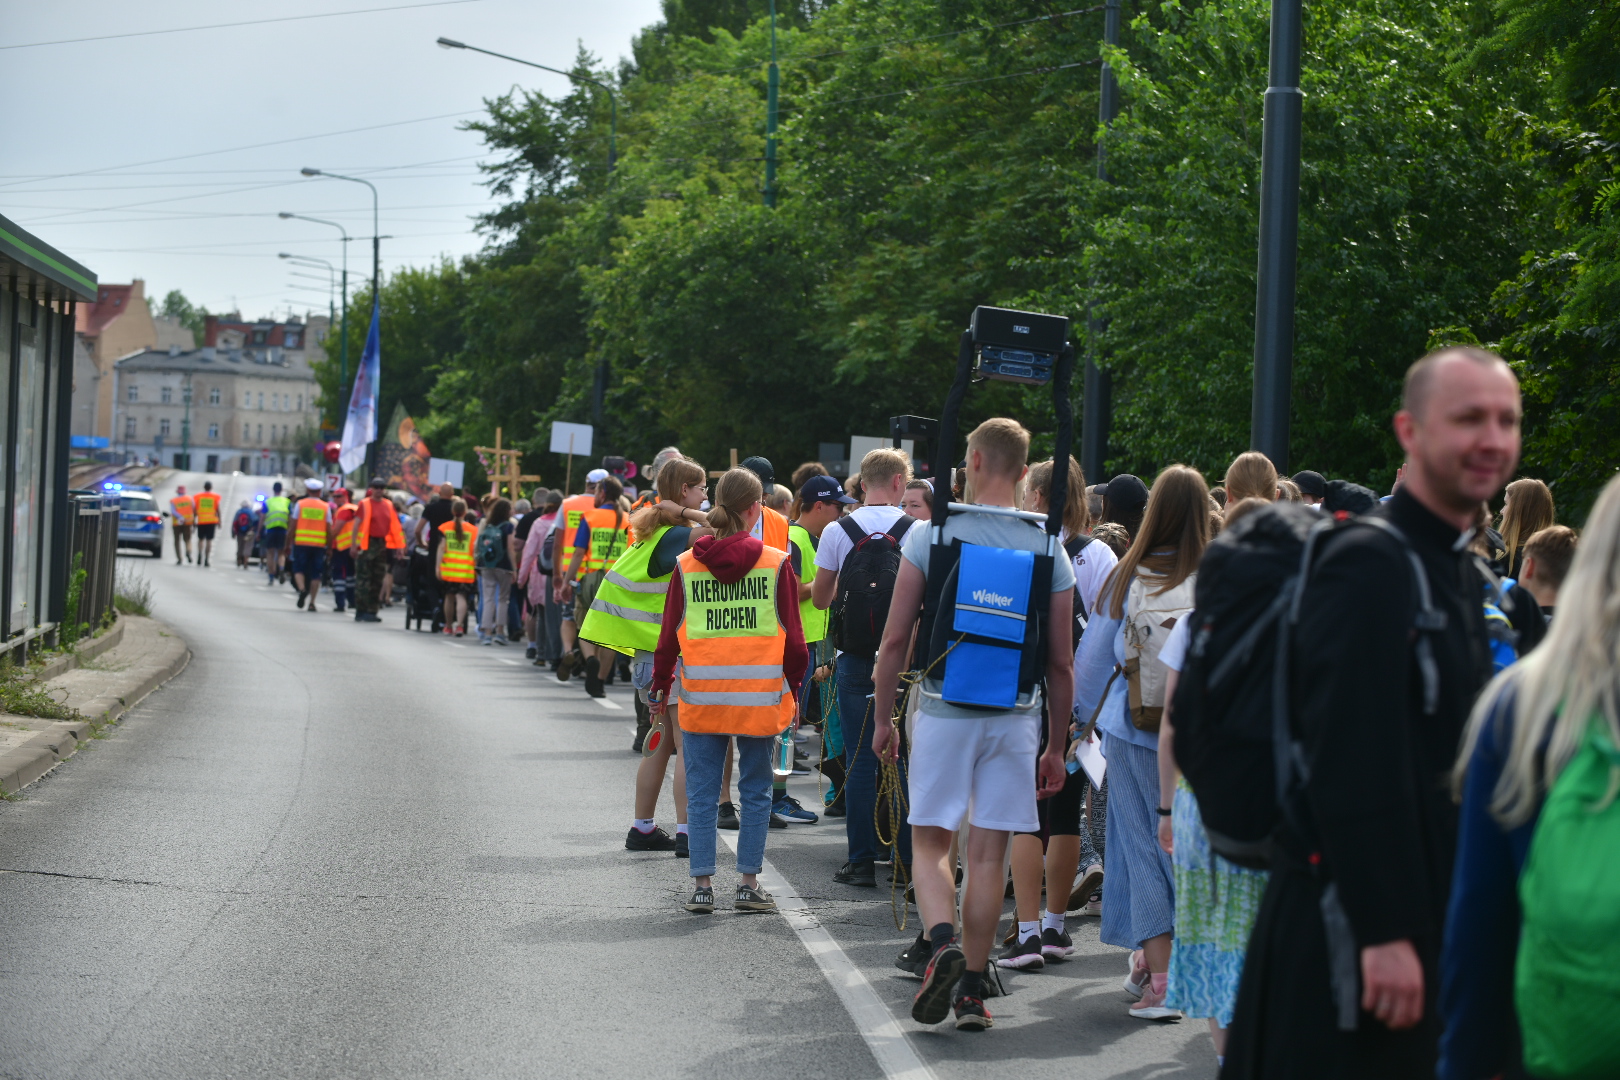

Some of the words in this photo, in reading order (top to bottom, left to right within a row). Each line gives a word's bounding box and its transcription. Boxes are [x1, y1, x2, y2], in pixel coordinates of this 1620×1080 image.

[328, 475, 339, 488] 7
[691, 577, 768, 602] KIEROWANIE
[972, 589, 1014, 607] Walker
[706, 607, 757, 630] RUCHEM
[695, 894, 713, 904] NIKE
